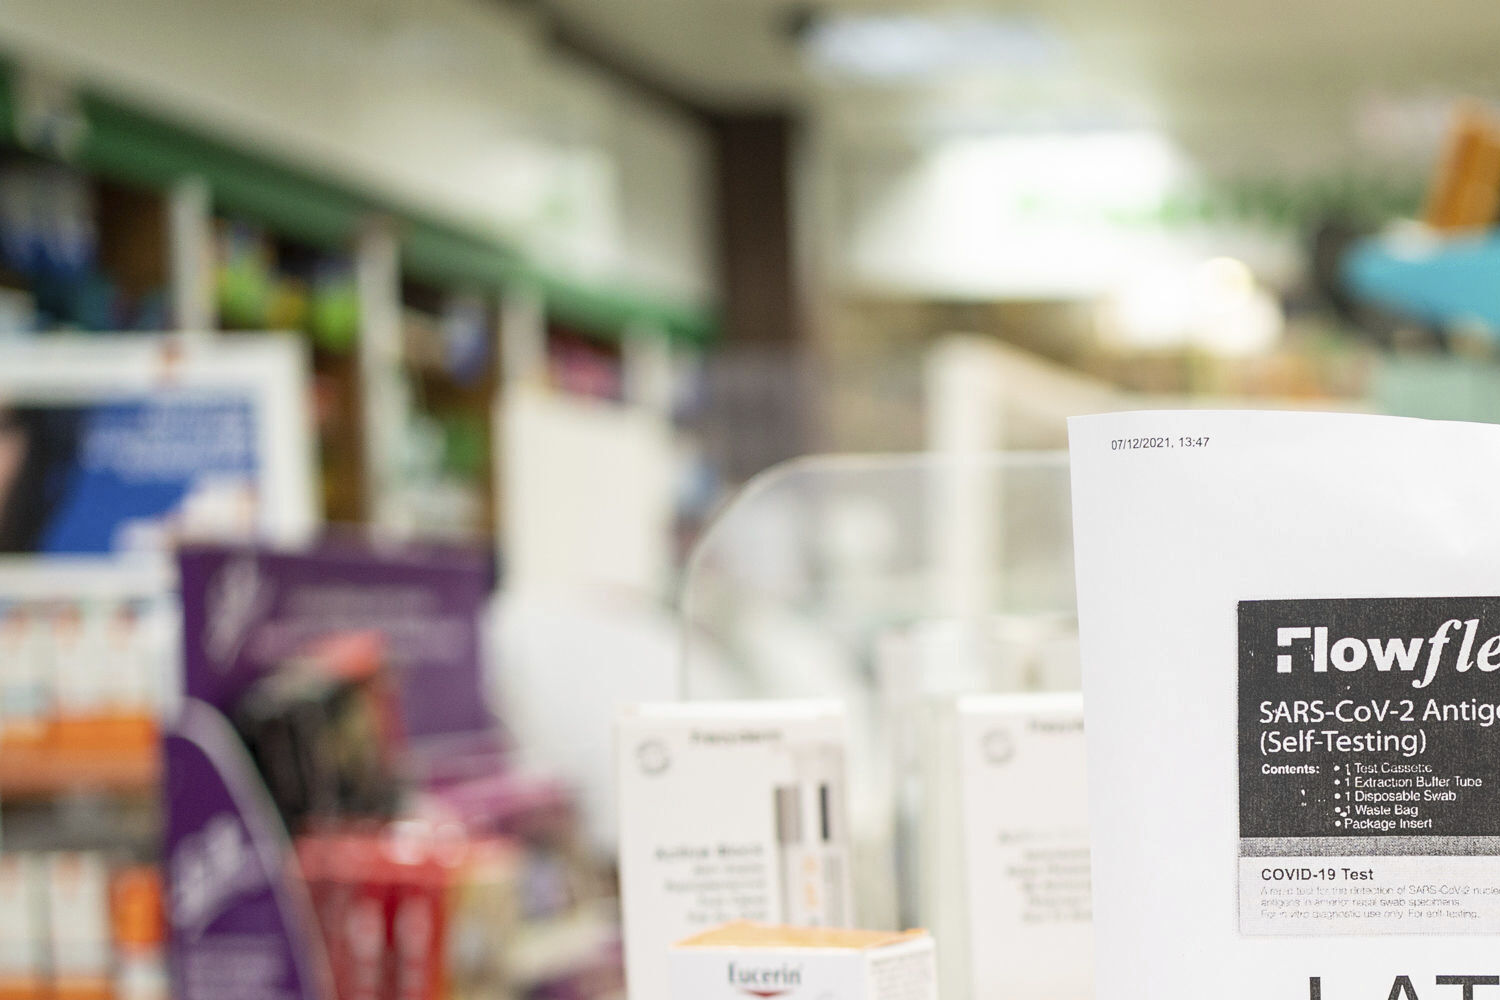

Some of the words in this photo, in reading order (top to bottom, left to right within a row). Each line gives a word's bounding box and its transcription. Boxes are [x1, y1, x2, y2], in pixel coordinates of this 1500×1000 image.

[1110, 437, 1174, 450] 07/12/2021,
[1178, 436, 1210, 447] 13:47
[1259, 699, 1415, 724] SARS-CoV-2
[1259, 730, 1427, 758] (Self-Testing)
[1261, 763, 1321, 775] Contents:
[1354, 762, 1379, 774] Test
[1345, 778, 1351, 788] 1
[1354, 776, 1413, 788] Extraction
[1454, 775, 1483, 788] Tube
[1345, 791, 1351, 801] 1
[1354, 790, 1421, 803] Disposable
[1423, 790, 1457, 801] Swab
[1354, 804, 1391, 815] Waste
[1394, 804, 1419, 817] Bag
[1344, 818, 1397, 832] Package
[1400, 817, 1433, 829] Insert
[1260, 867, 1336, 881] COVID-19
[1342, 868, 1375, 881] Test
[727, 961, 802, 986] Eucerin
